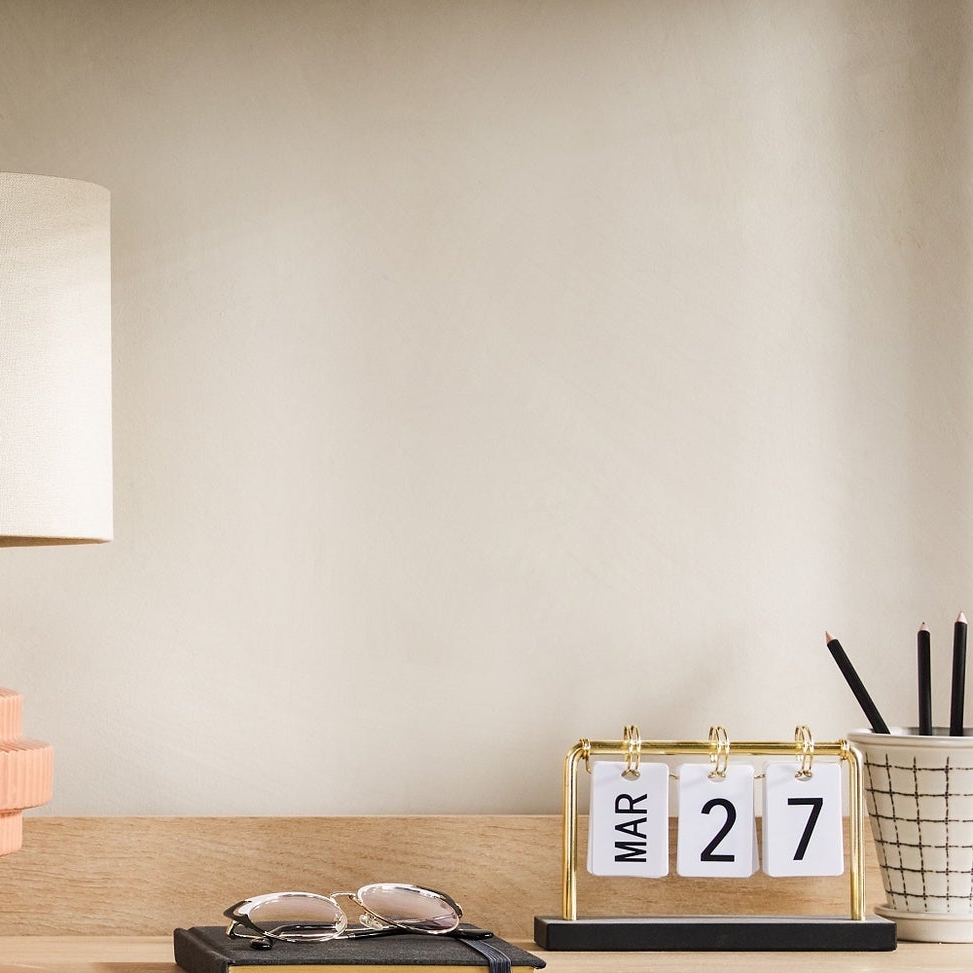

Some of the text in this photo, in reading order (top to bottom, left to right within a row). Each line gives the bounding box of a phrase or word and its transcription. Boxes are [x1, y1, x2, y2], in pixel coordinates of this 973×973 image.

[614, 793, 648, 863] MAR
[700, 797, 824, 863] 2 7
